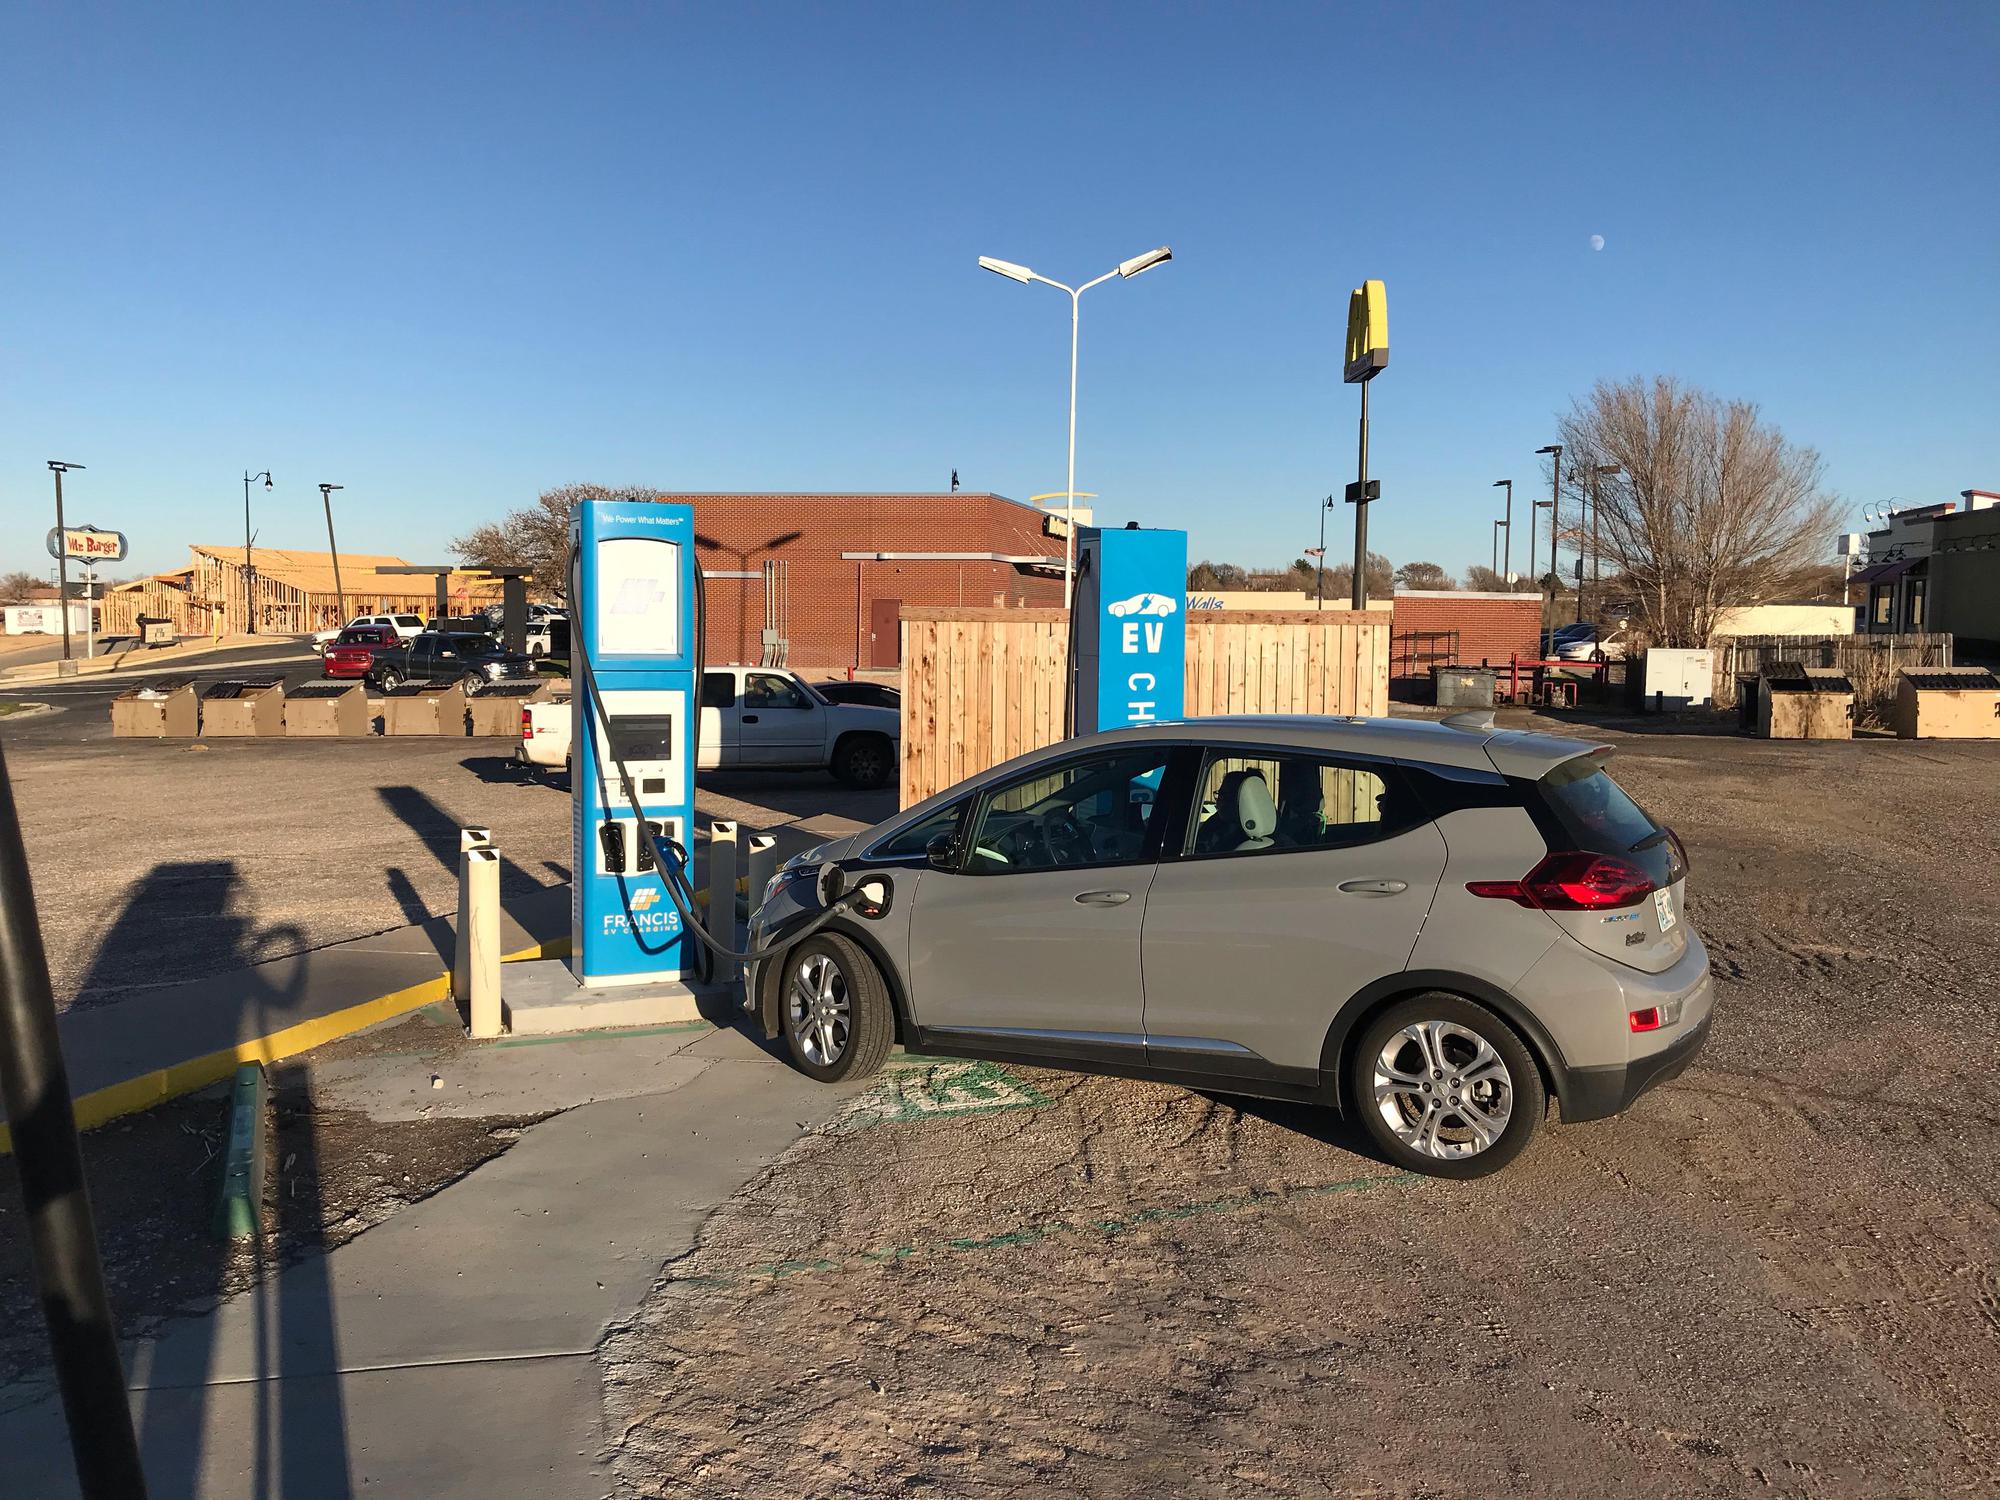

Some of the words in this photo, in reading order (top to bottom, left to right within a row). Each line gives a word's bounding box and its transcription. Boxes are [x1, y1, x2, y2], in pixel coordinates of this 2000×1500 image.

[616, 514, 637, 524] Power
[637, 515, 656, 525] What
[86, 536, 117, 555] Burger
[1122, 622, 1164, 654] EV
[603, 911, 678, 928] FRANCIS
[603, 928, 617, 936] EV
